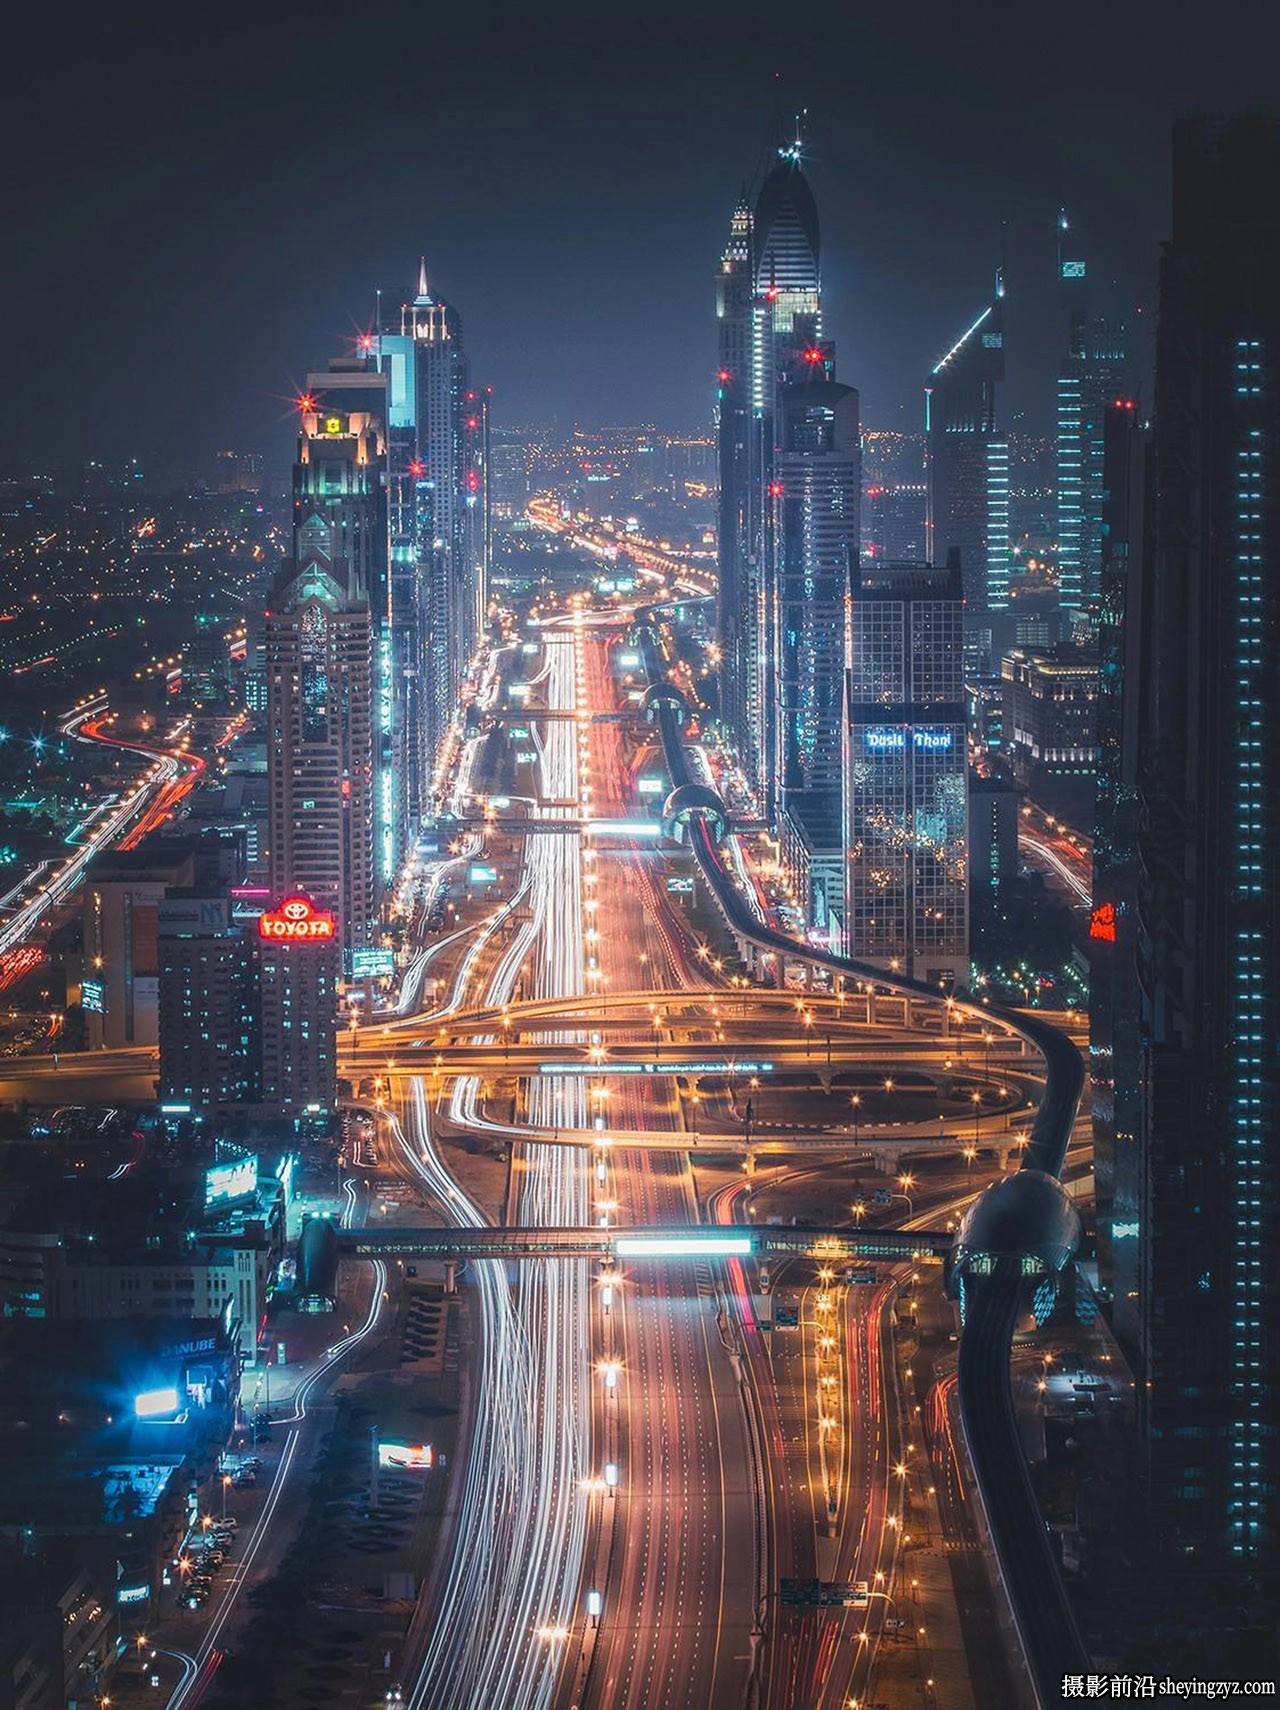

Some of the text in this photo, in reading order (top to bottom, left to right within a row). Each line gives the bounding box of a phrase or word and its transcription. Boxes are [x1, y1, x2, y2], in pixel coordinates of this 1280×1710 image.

[867, 731, 952, 748] Dusit Thani
[262, 921, 330, 936] TOYOTA
